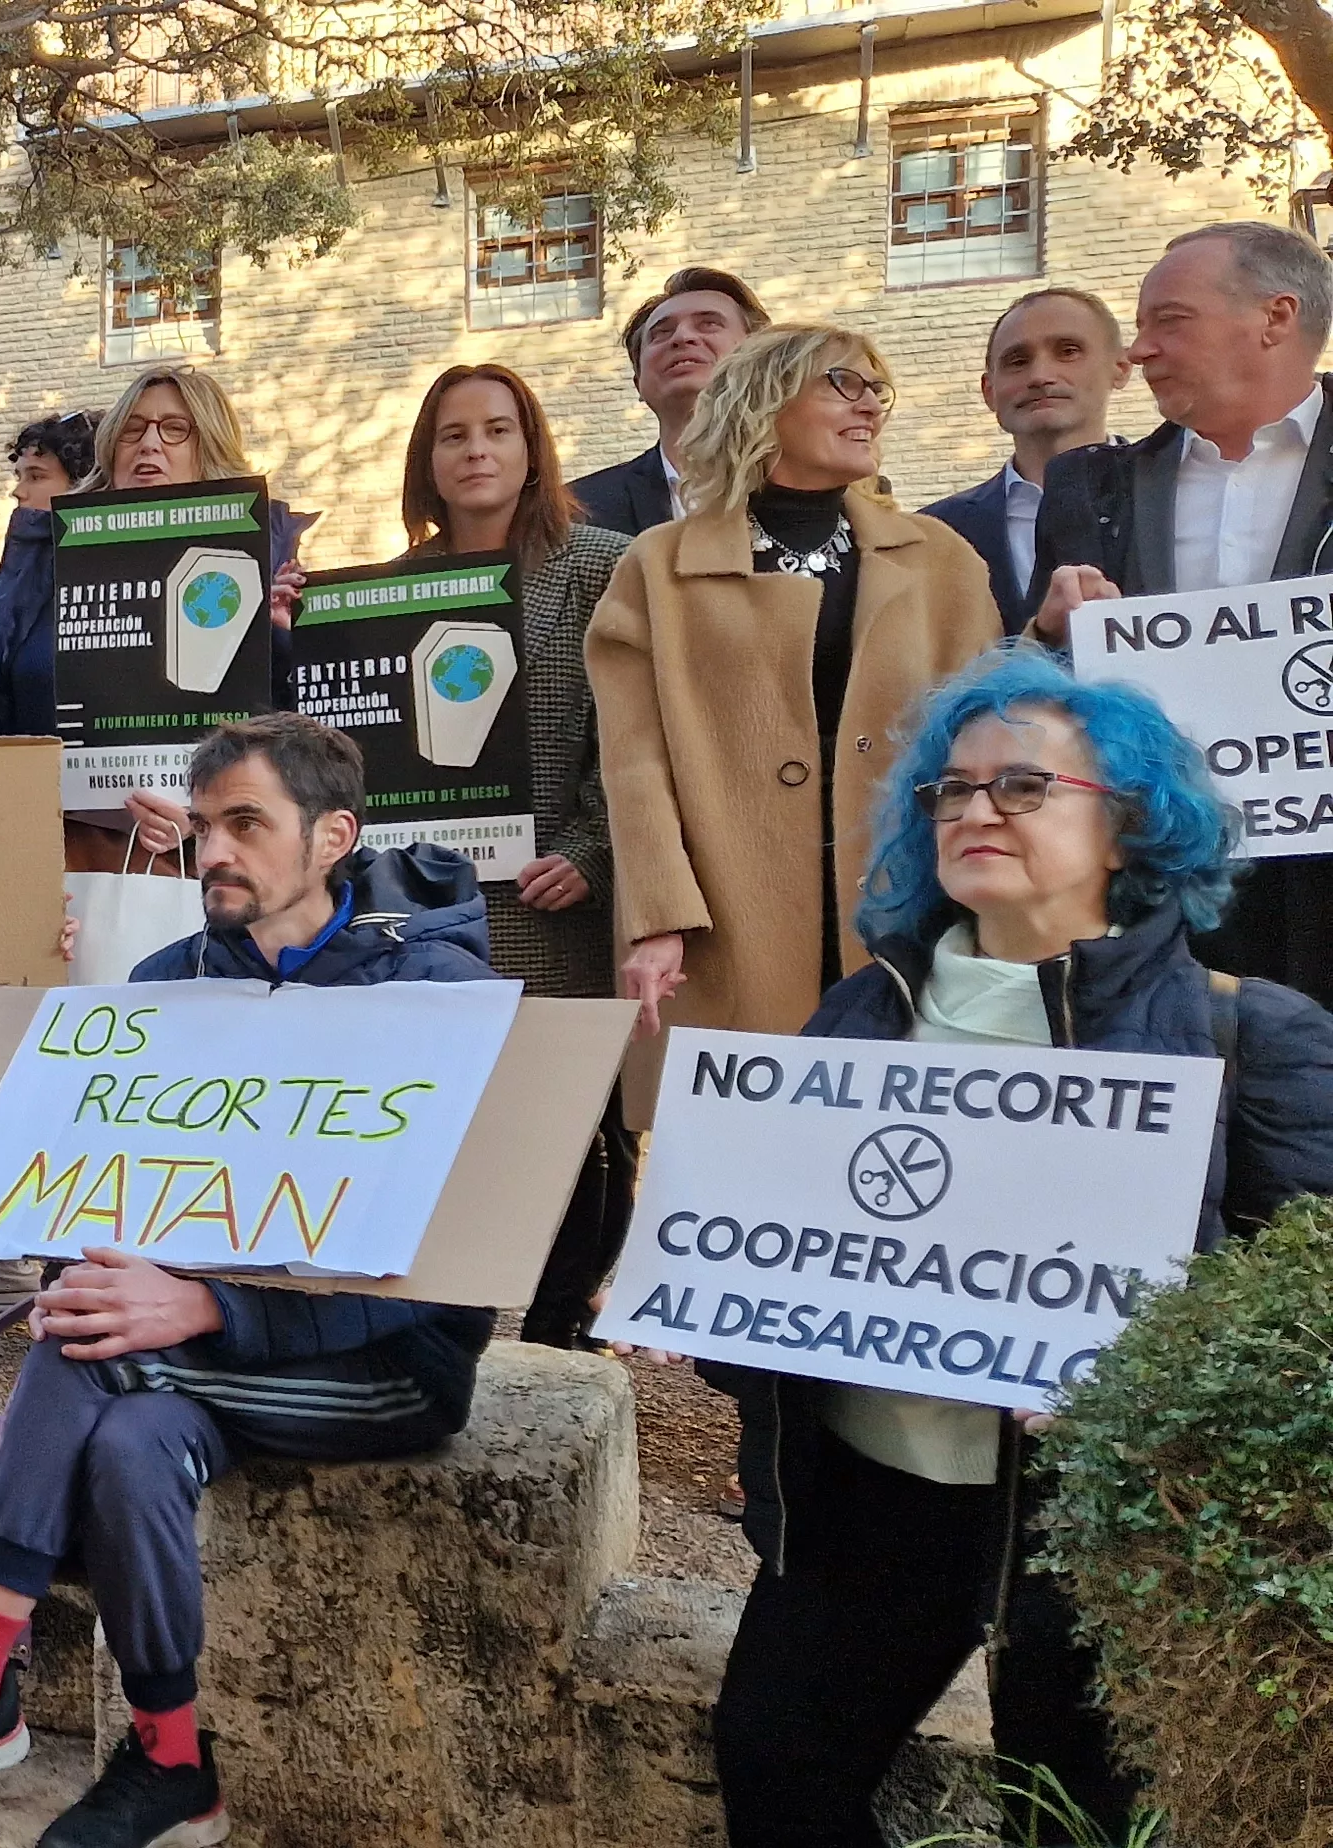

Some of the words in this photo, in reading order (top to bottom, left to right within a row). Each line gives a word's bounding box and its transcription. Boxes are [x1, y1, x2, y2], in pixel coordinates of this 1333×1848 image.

[70, 515, 102, 534] ¡NOS
[107, 510, 164, 531] QUIEREN
[169, 502, 245, 527] ENTERRAR!
[59, 579, 162, 605] ENTIERRO
[307, 592, 341, 613] ¡NOS
[346, 585, 408, 609] QUIEREN
[412, 575, 495, 601] ENTERRAR!
[59, 604, 89, 620] POR
[98, 603, 117, 618] LA
[57, 614, 143, 636] COOPERACIÓN
[1104, 612, 1192, 653] NO
[1205, 603, 1277, 645] AL
[57, 632, 154, 652] INTERNACIONAL
[297, 655, 407, 684] ENTIERRO
[298, 683, 330, 700] POR
[340, 680, 360, 696] LA
[297, 691, 389, 715] COOPERACIÓN
[94, 714, 178, 730] AYUNTAMIENTO
[183, 713, 198, 726] DE
[66, 757, 80, 769] NO
[84, 756, 97, 768] AL
[101, 755, 149, 768] RECORTE
[154, 754, 168, 766] EN
[89, 774, 134, 789] HUESCA
[140, 774, 154, 788] ES
[441, 790, 456, 801] DE
[462, 785, 510, 801] HUESCA
[360, 832, 405, 846] ECORTE
[412, 831, 426, 843] EN
[434, 823, 523, 841] COOPERACIÓN
[37, 1002, 158, 1057] LOS
[692, 1051, 784, 1103] NO
[790, 1060, 864, 1110] AL
[878, 1065, 1176, 1134] RECORTE
[74, 1074, 435, 1139] RECORTES
[658, 1211, 1142, 1319] COOPERACIÓN
[630, 1284, 699, 1332] AL
